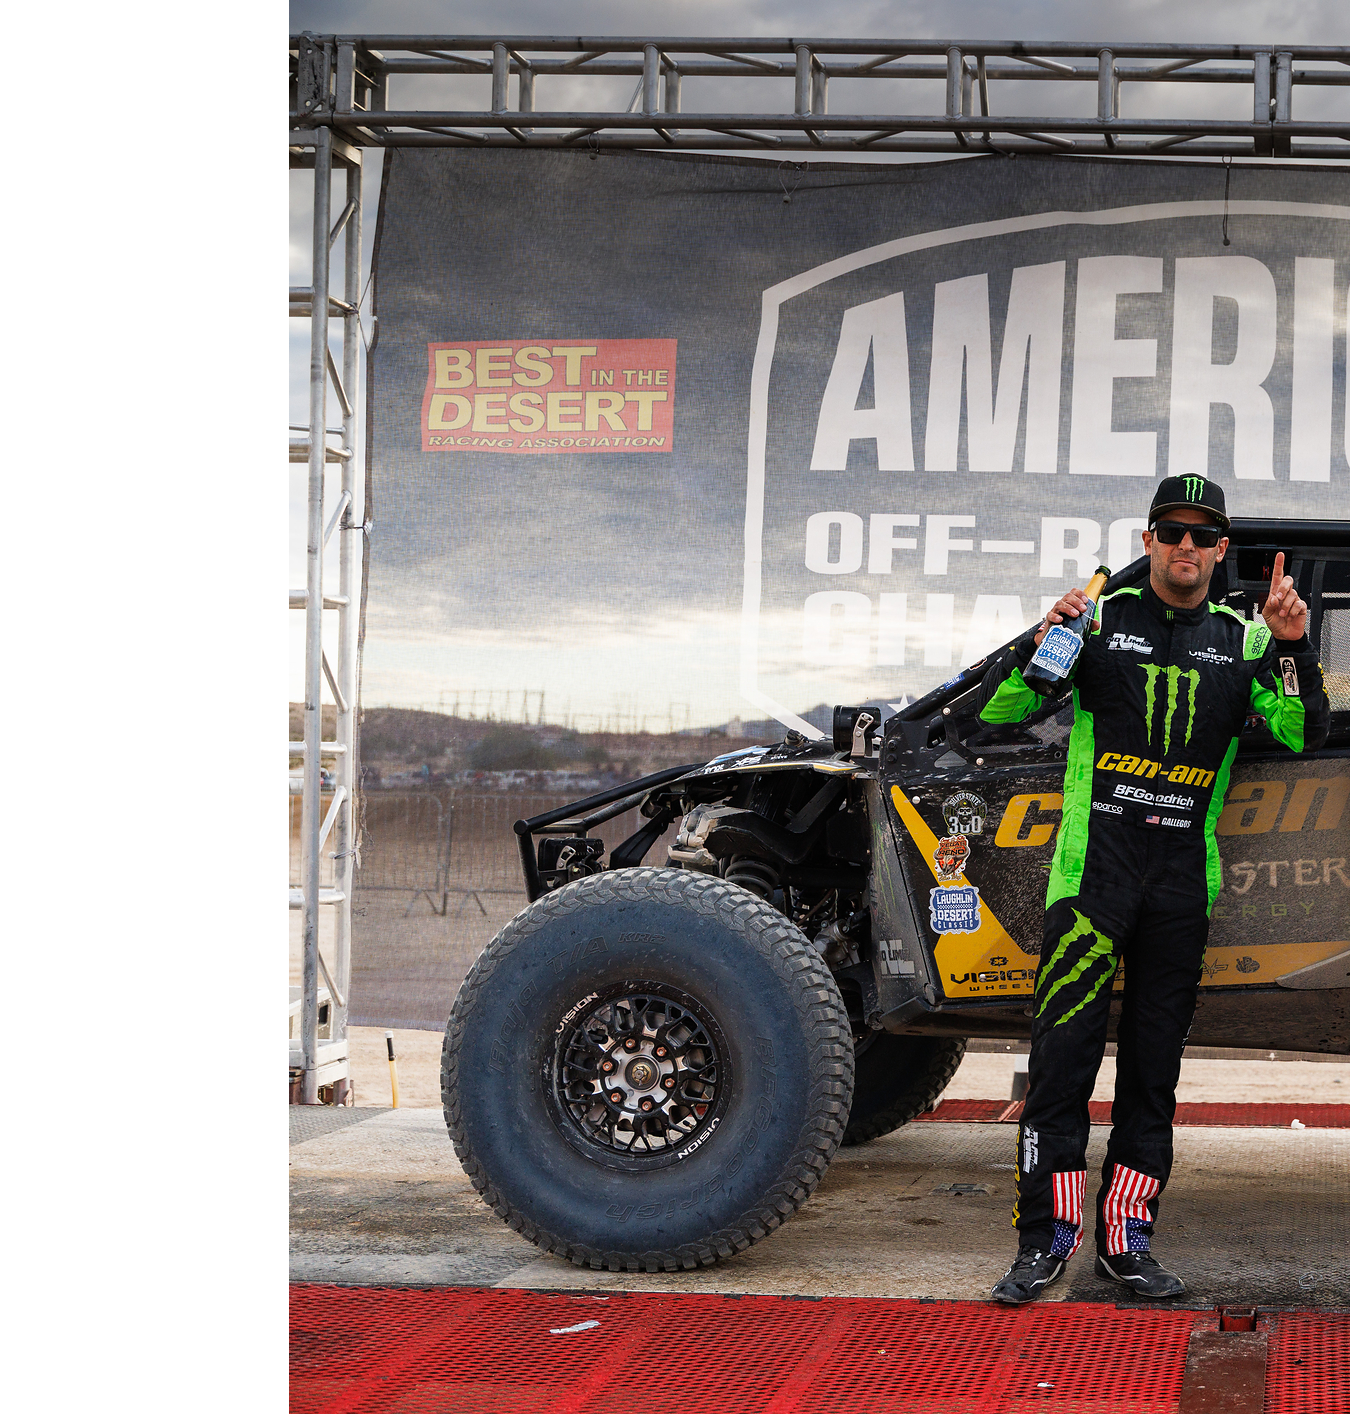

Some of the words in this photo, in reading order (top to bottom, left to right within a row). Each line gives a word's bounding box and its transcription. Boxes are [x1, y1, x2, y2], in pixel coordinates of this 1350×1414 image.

[434, 346, 598, 389] BEST
[591, 369, 614, 386] IN
[622, 369, 669, 386] THE
[427, 391, 669, 433] DESERT
[428, 436, 513, 448] RACING
[518, 436, 666, 449] ASSOCIATION
[1043, 642, 1072, 660] DESERT
[1049, 632, 1077, 652] LAUGHLIN
[1188, 650, 1234, 663] VISION
[1096, 752, 1215, 788] can-am
[1114, 783, 1194, 807] BFGoodrich
[1092, 801, 1123, 813] sparco
[1161, 817, 1192, 828] GALLEGOS
[936, 893, 973, 904] LAUGHLIN
[937, 909, 974, 921] DESERT
[1214, 901, 1315, 919] ERGY
[937, 920, 974, 928] CLASSIC
[969, 983, 1033, 991] WHEEL
[555, 992, 598, 1034] VISION
[677, 1117, 720, 1159] VISION
